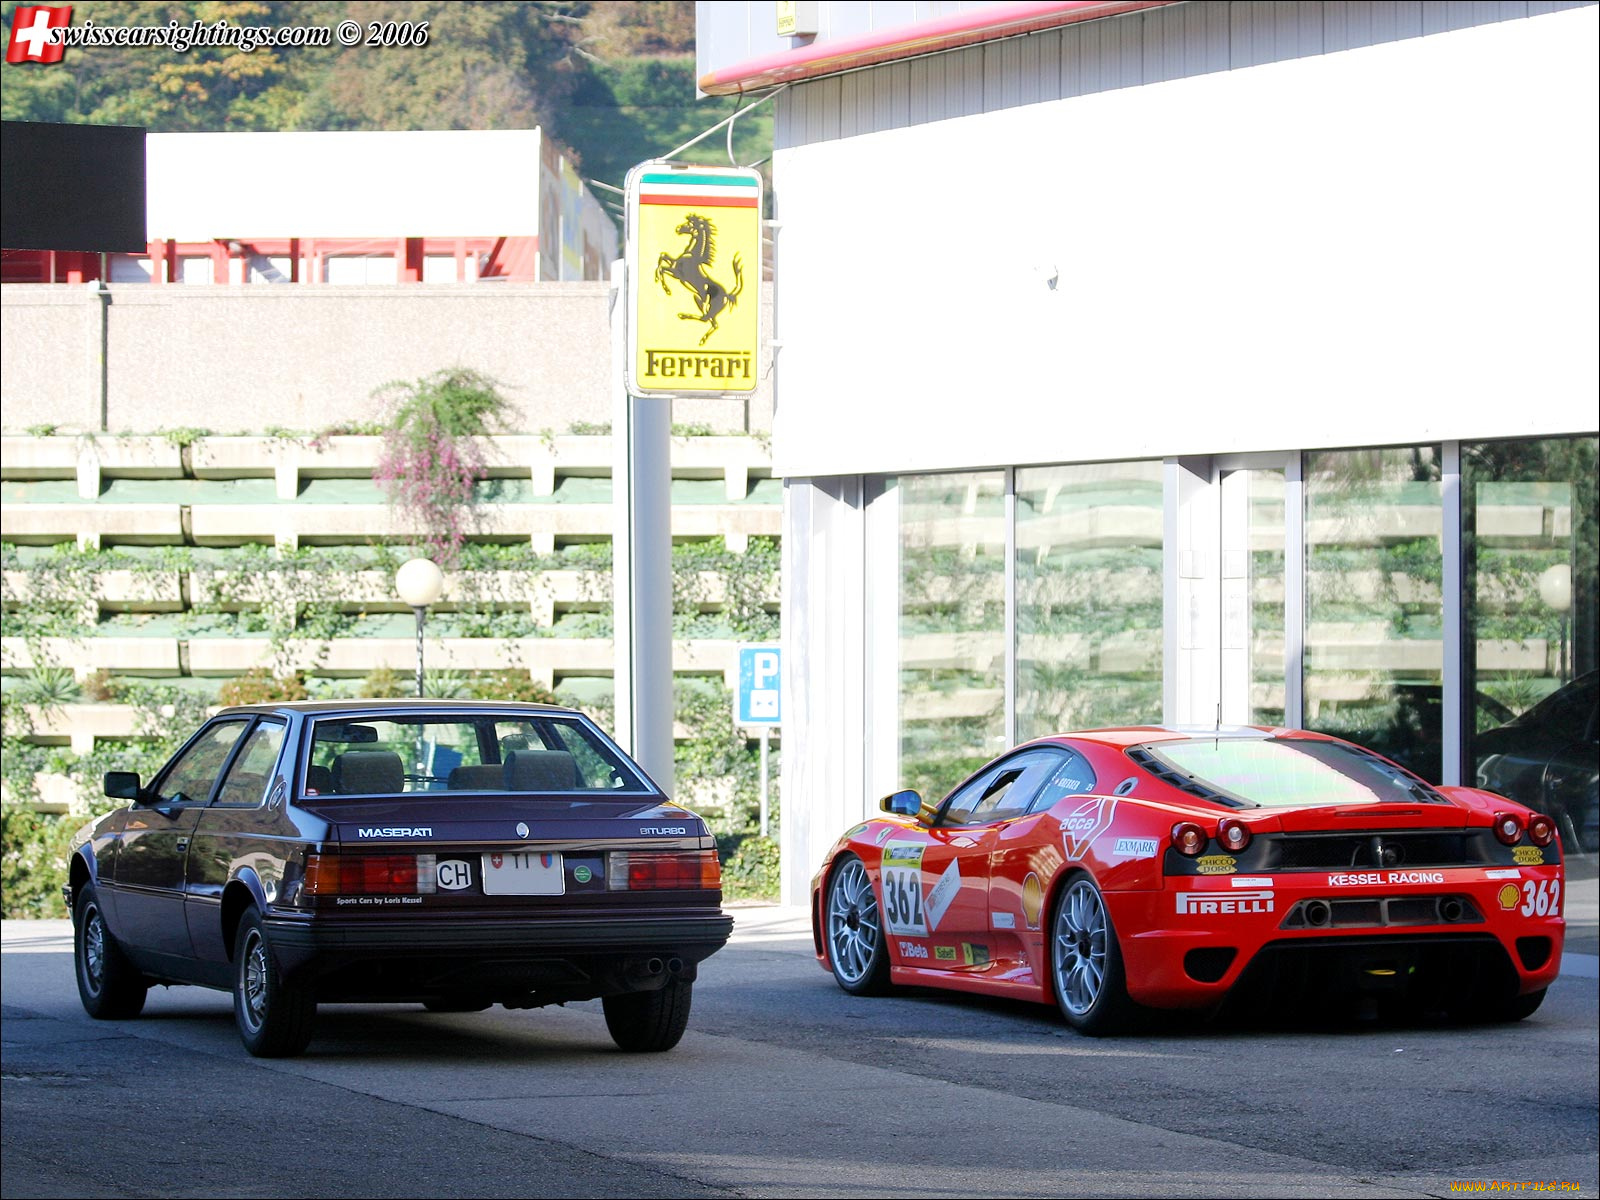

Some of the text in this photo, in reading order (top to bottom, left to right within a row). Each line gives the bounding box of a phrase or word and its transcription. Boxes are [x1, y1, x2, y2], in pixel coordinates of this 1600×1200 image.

[645, 350, 751, 378] Ferrari
[754, 652, 779, 689] P
[640, 827, 686, 835] BITURBO
[1059, 818, 1095, 831] acca
[358, 827, 433, 838] MASERATI
[1115, 840, 1156, 855] LEXMARK
[512, 853, 530, 869] TI
[1200, 858, 1234, 866] CHICCO
[439, 864, 469, 886] CH
[1203, 865, 1232, 873] D'ORO
[1328, 872, 1444, 886] KESSEL RACING
[337, 897, 357, 906] Sports
[374, 897, 383, 905] by
[402, 896, 423, 904] Kessel
[886, 870, 924, 926] 362
[1176, 890, 1275, 914] PIRELLI
[1521, 879, 1560, 917] 362
[907, 942, 929, 959] Beta
